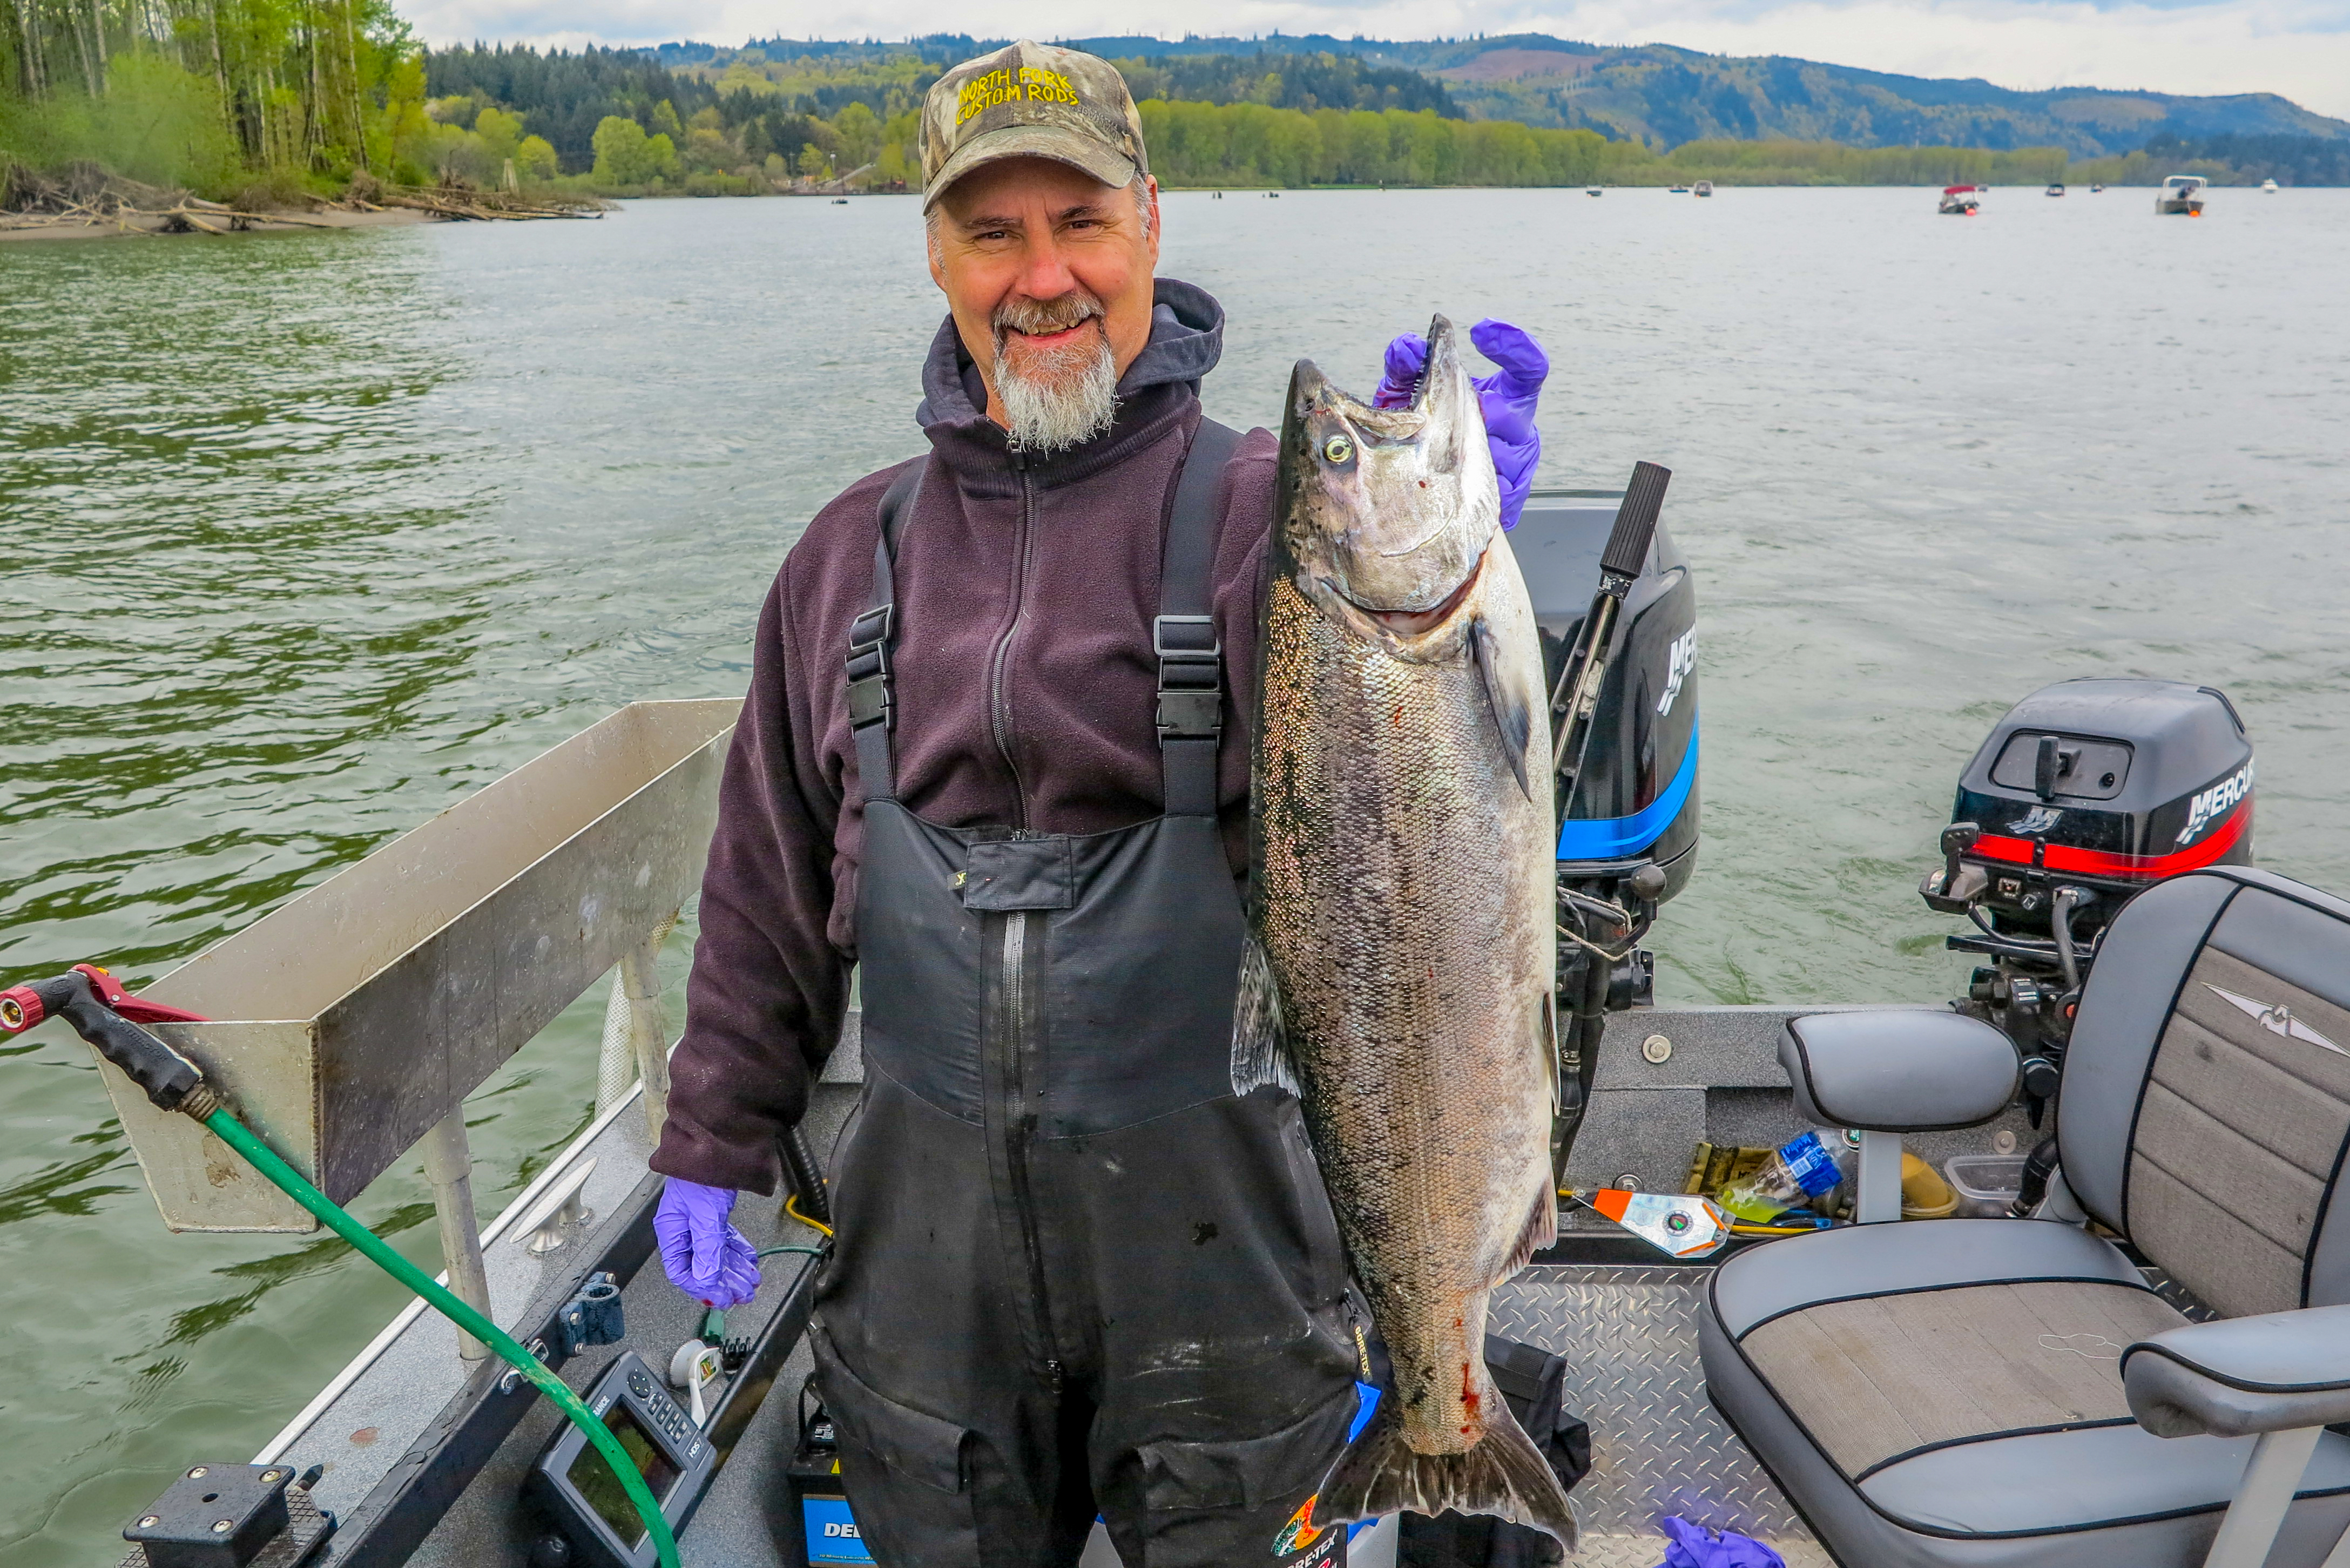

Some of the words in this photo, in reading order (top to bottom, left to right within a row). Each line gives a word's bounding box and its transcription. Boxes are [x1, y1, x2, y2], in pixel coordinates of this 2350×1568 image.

[956, 84, 1022, 125] CUSTOM
[1027, 83, 1079, 106] RODS
[958, 67, 1011, 106] NORTH
[1018, 67, 1073, 90] FORK
[1287, 1528, 1339, 1568] RE-TEX
